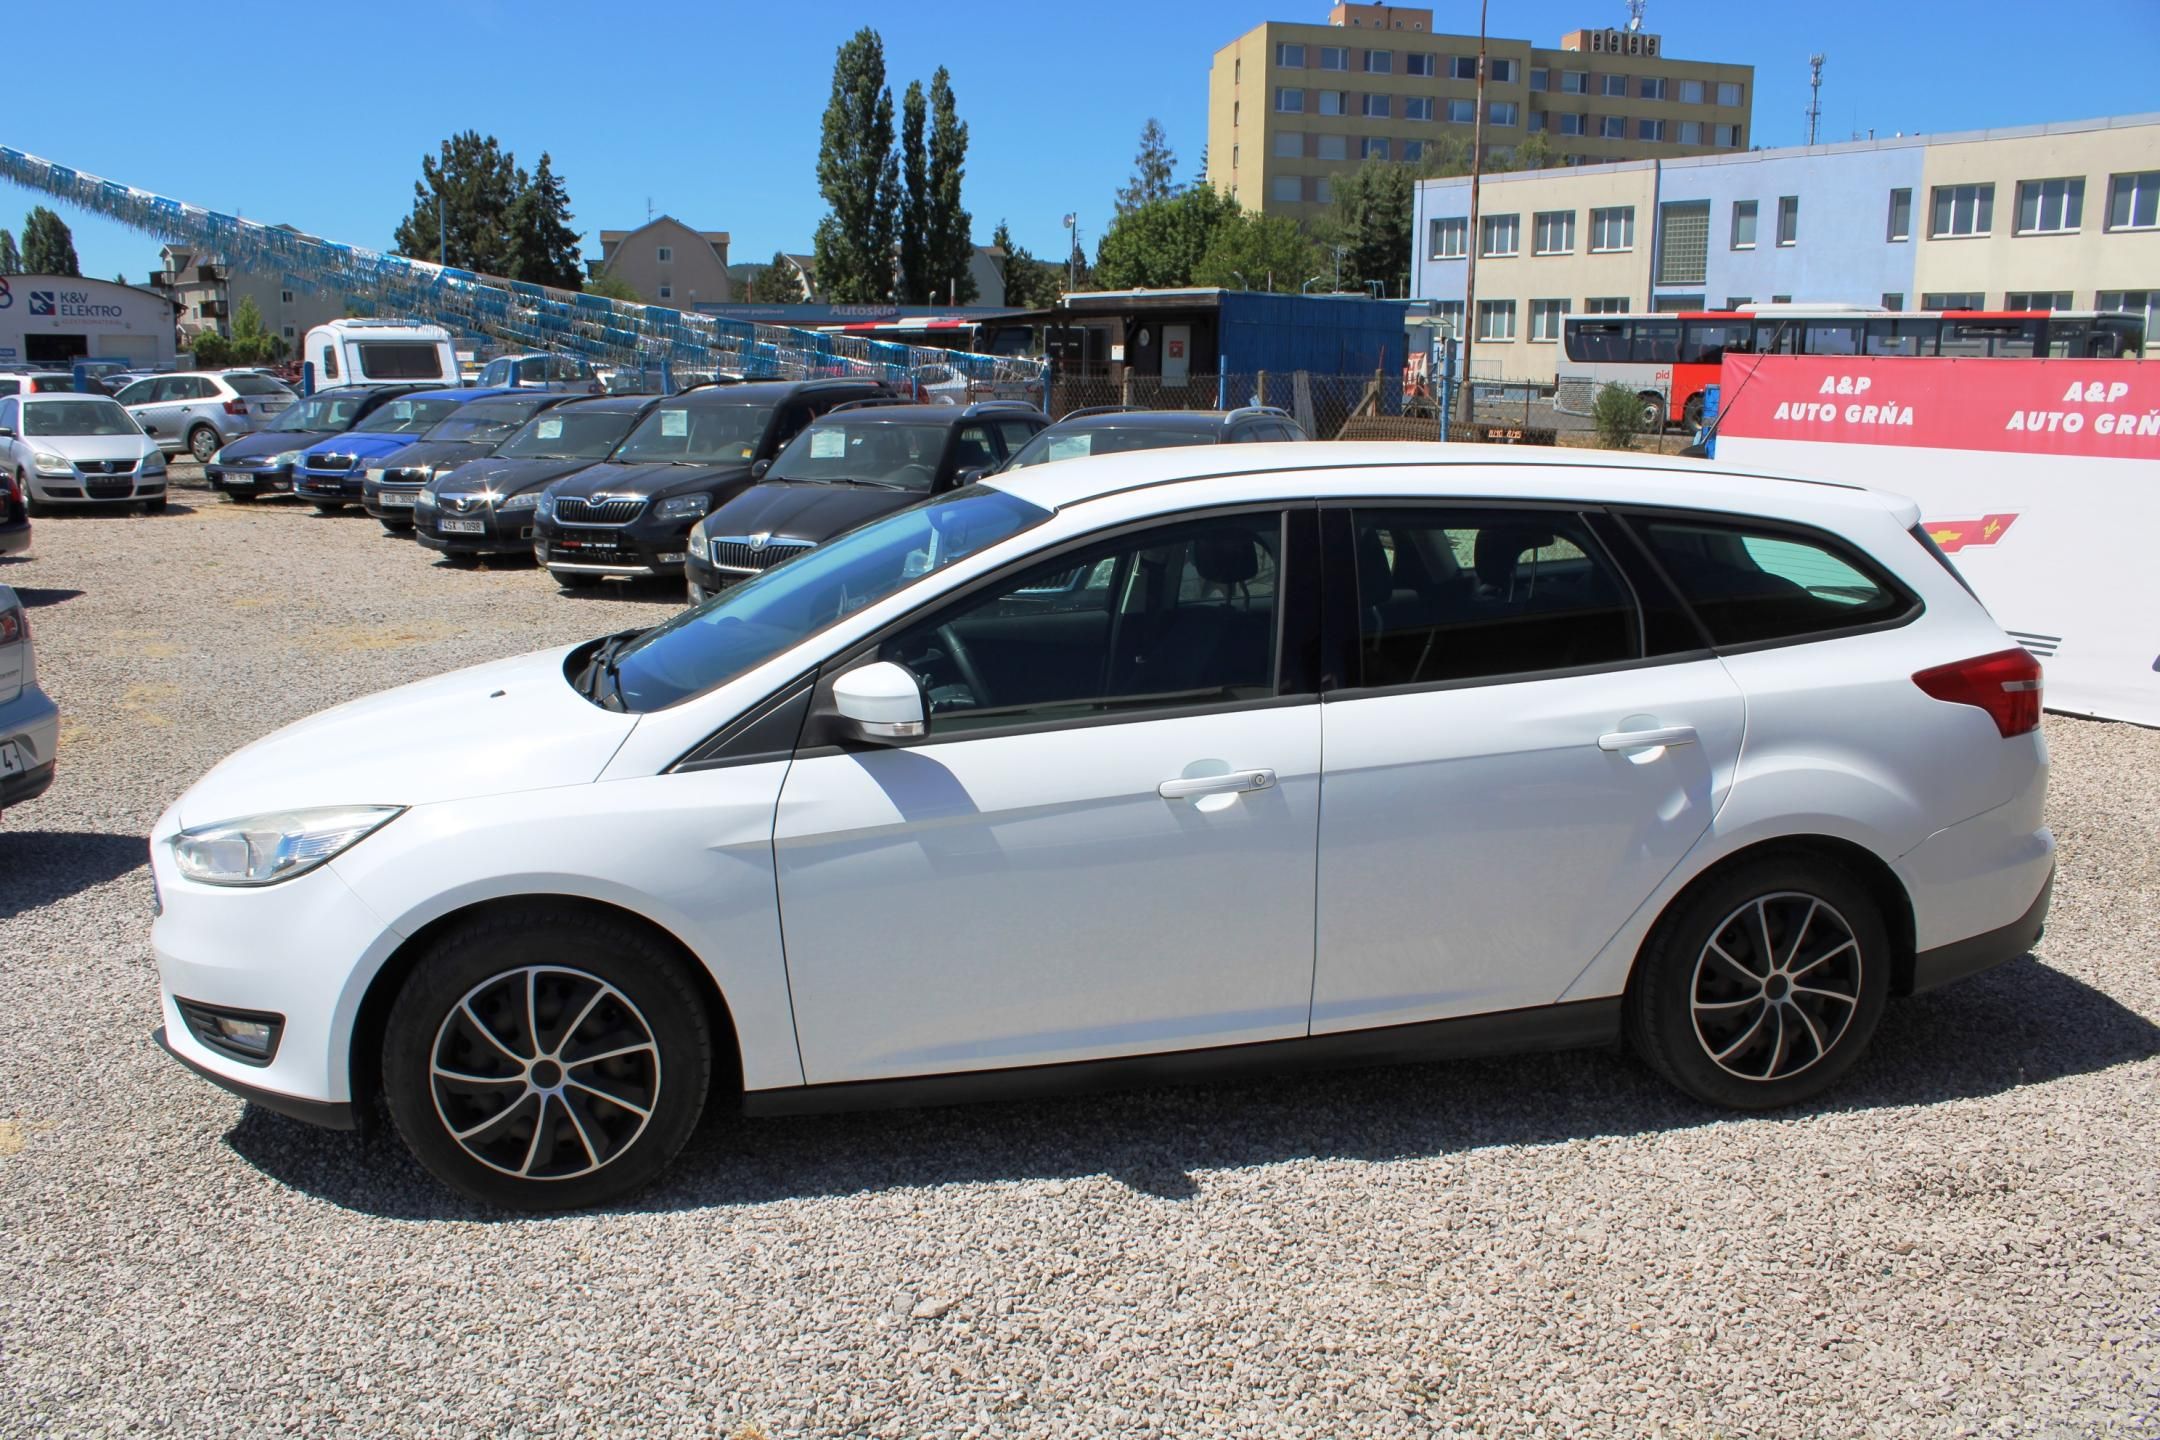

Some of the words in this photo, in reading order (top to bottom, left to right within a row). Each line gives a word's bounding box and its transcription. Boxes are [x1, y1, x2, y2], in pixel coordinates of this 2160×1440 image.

[60, 291, 89, 304] K&V
[61, 304, 122, 317] ELEKTRO
[1655, 369, 1670, 381] pid
[1818, 375, 1872, 395] A&P
[2062, 381, 2129, 403] A&P
[1773, 401, 1837, 422] AUTO
[1844, 400, 1914, 426] GRŇA
[2005, 410, 2085, 433] AUTO
[2094, 409, 2160, 436] GRŇ
